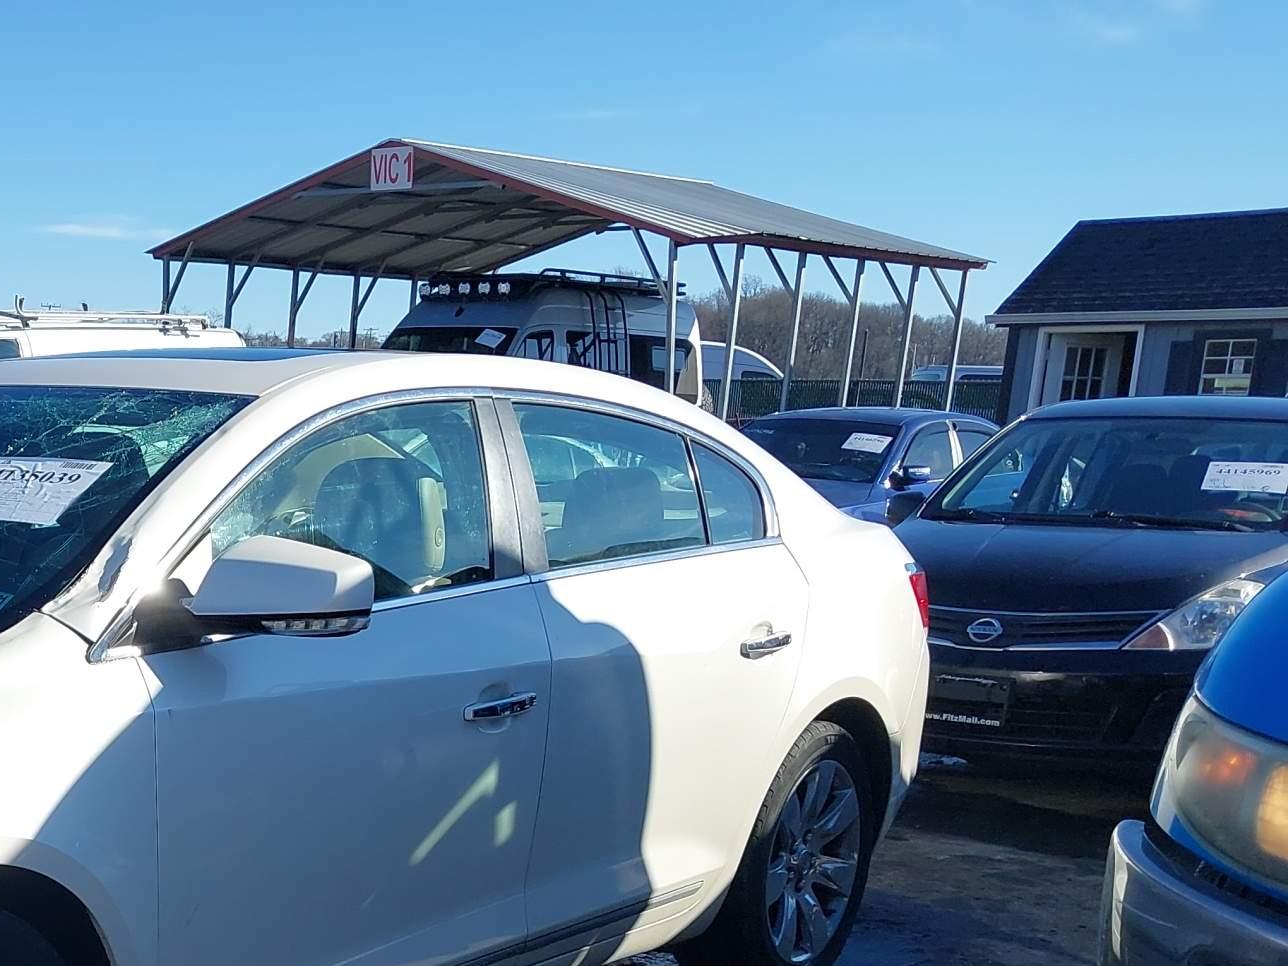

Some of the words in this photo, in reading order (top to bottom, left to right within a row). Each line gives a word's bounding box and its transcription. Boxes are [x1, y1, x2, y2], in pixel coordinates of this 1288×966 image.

[373, 152, 400, 185] VIC
[403, 151, 412, 183] 1
[925, 711, 1000, 727] ww.FitzMall.com
